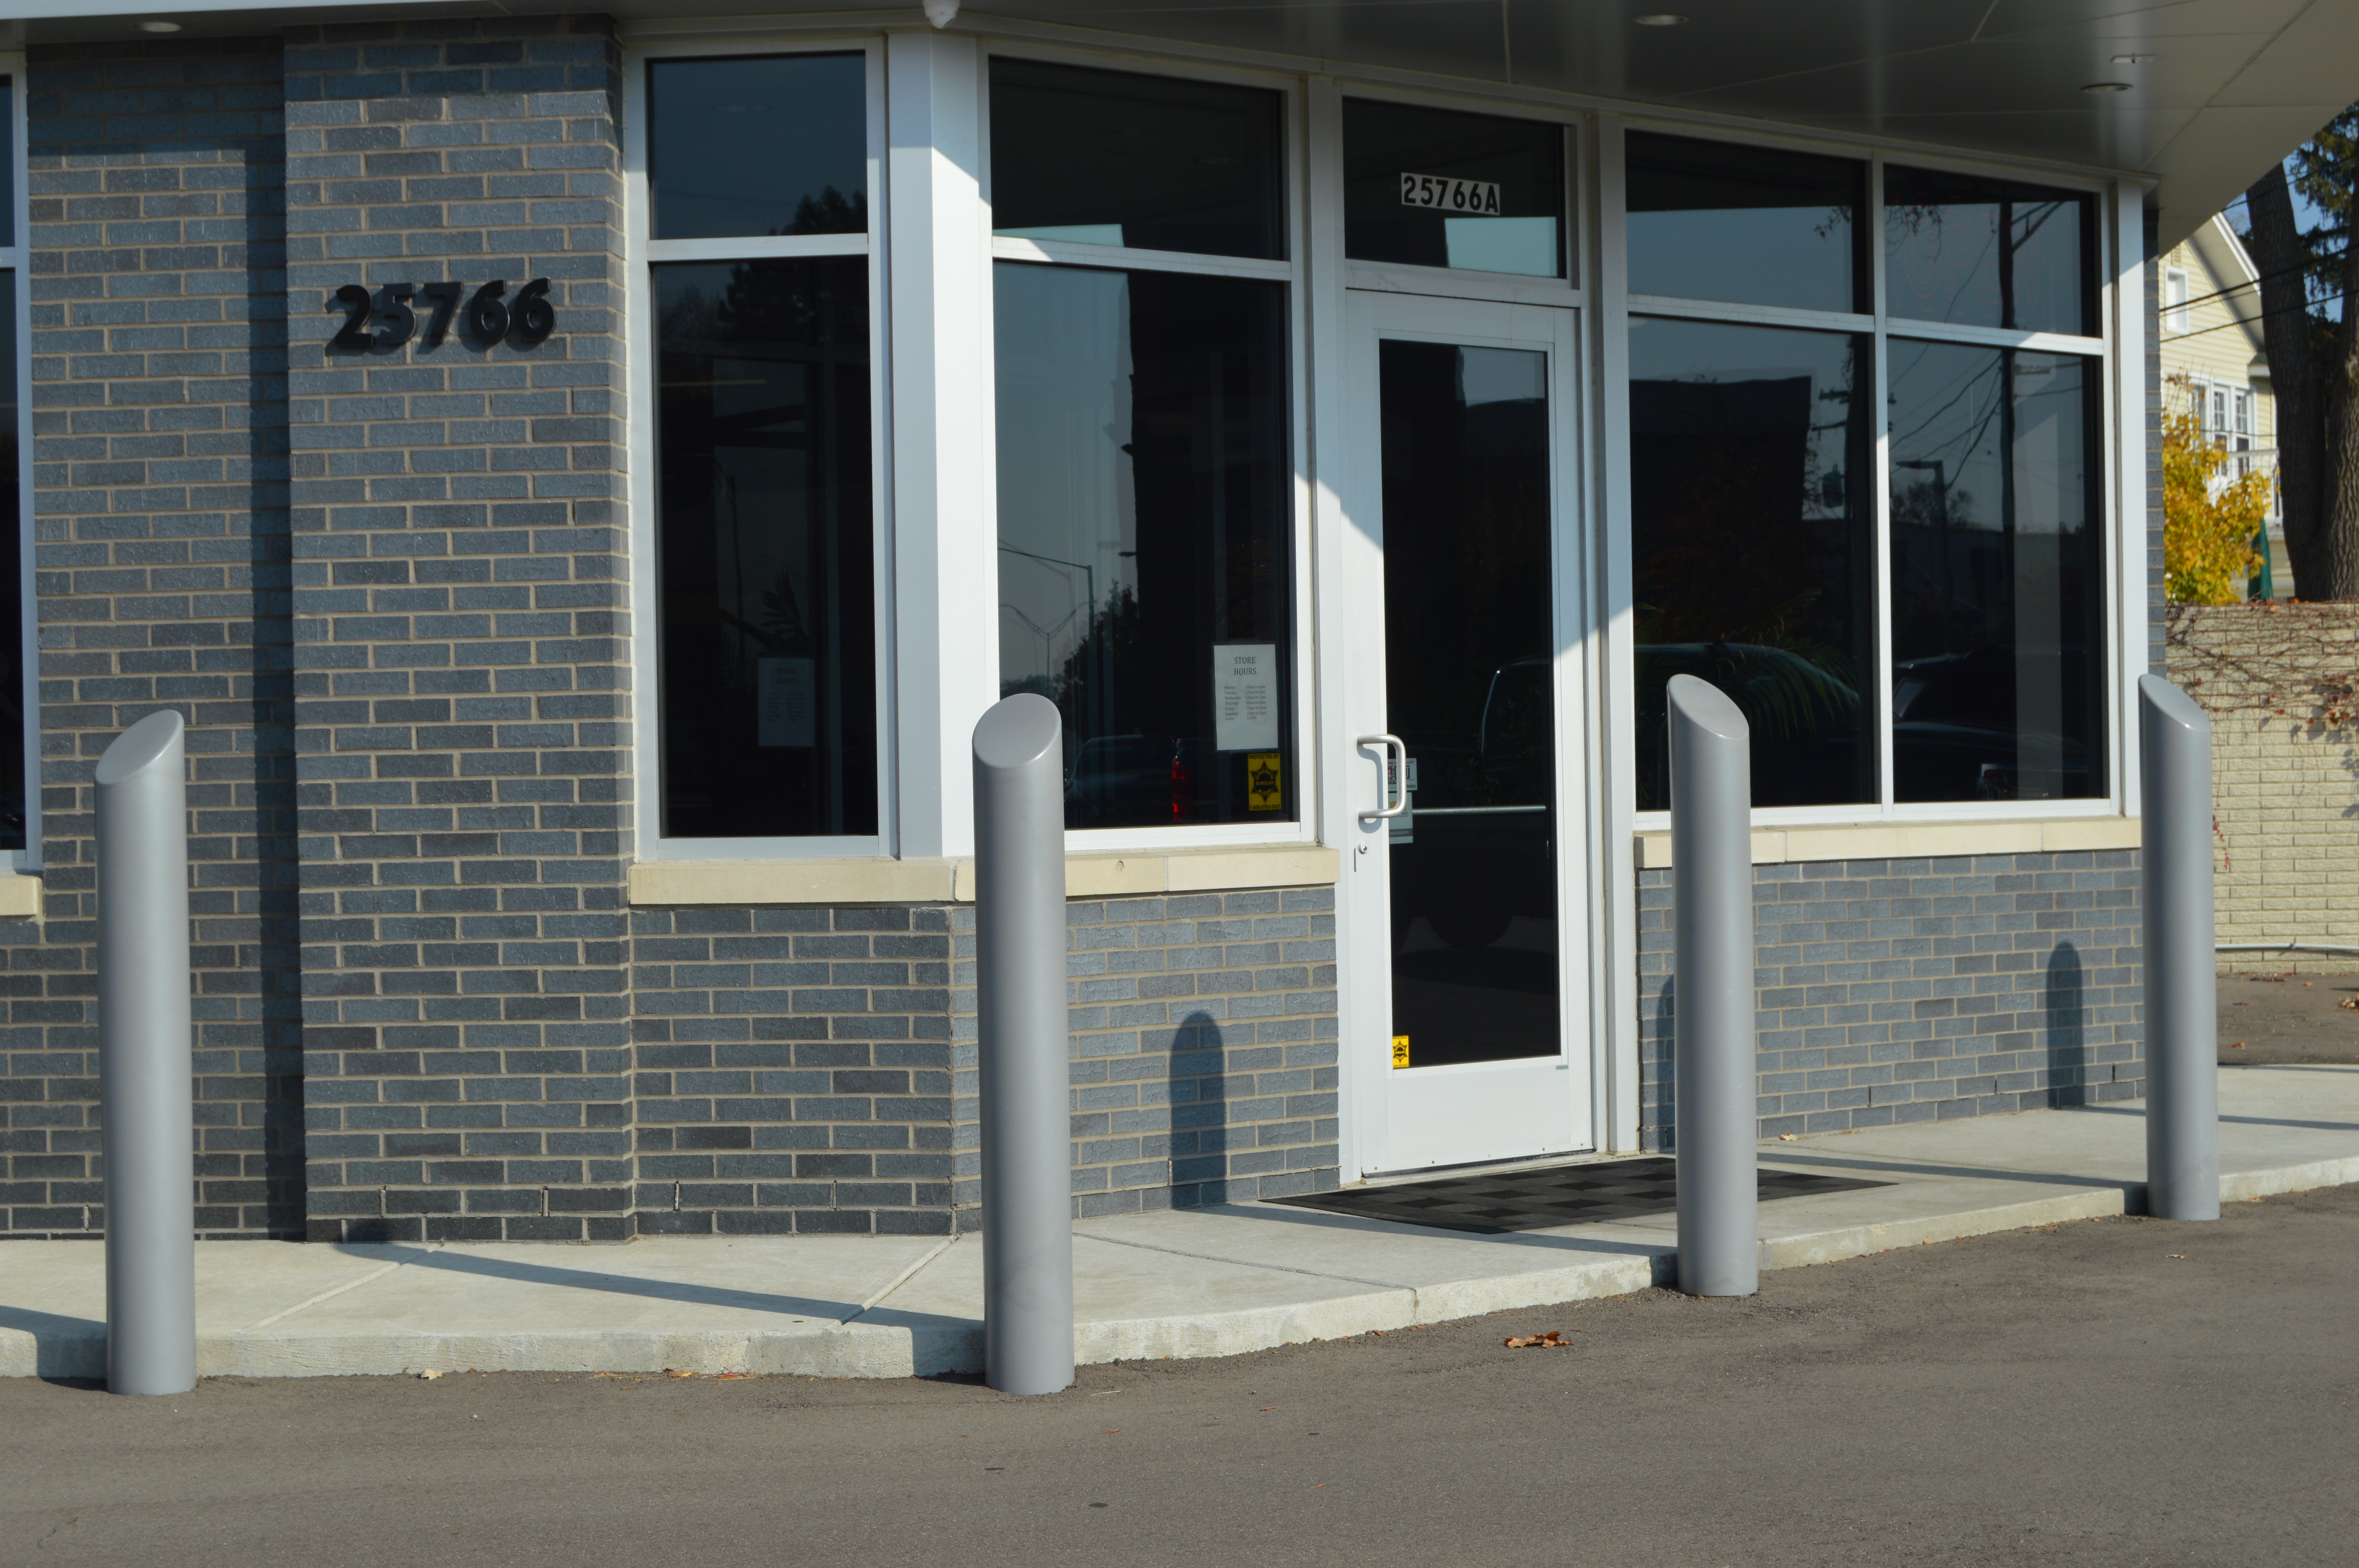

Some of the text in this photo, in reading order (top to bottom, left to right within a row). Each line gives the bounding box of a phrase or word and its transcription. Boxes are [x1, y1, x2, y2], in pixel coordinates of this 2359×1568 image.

[1403, 175, 1499, 213] 25766A
[334, 278, 556, 347] 25766
[1255, 769, 1274, 780] GUARDIAN
